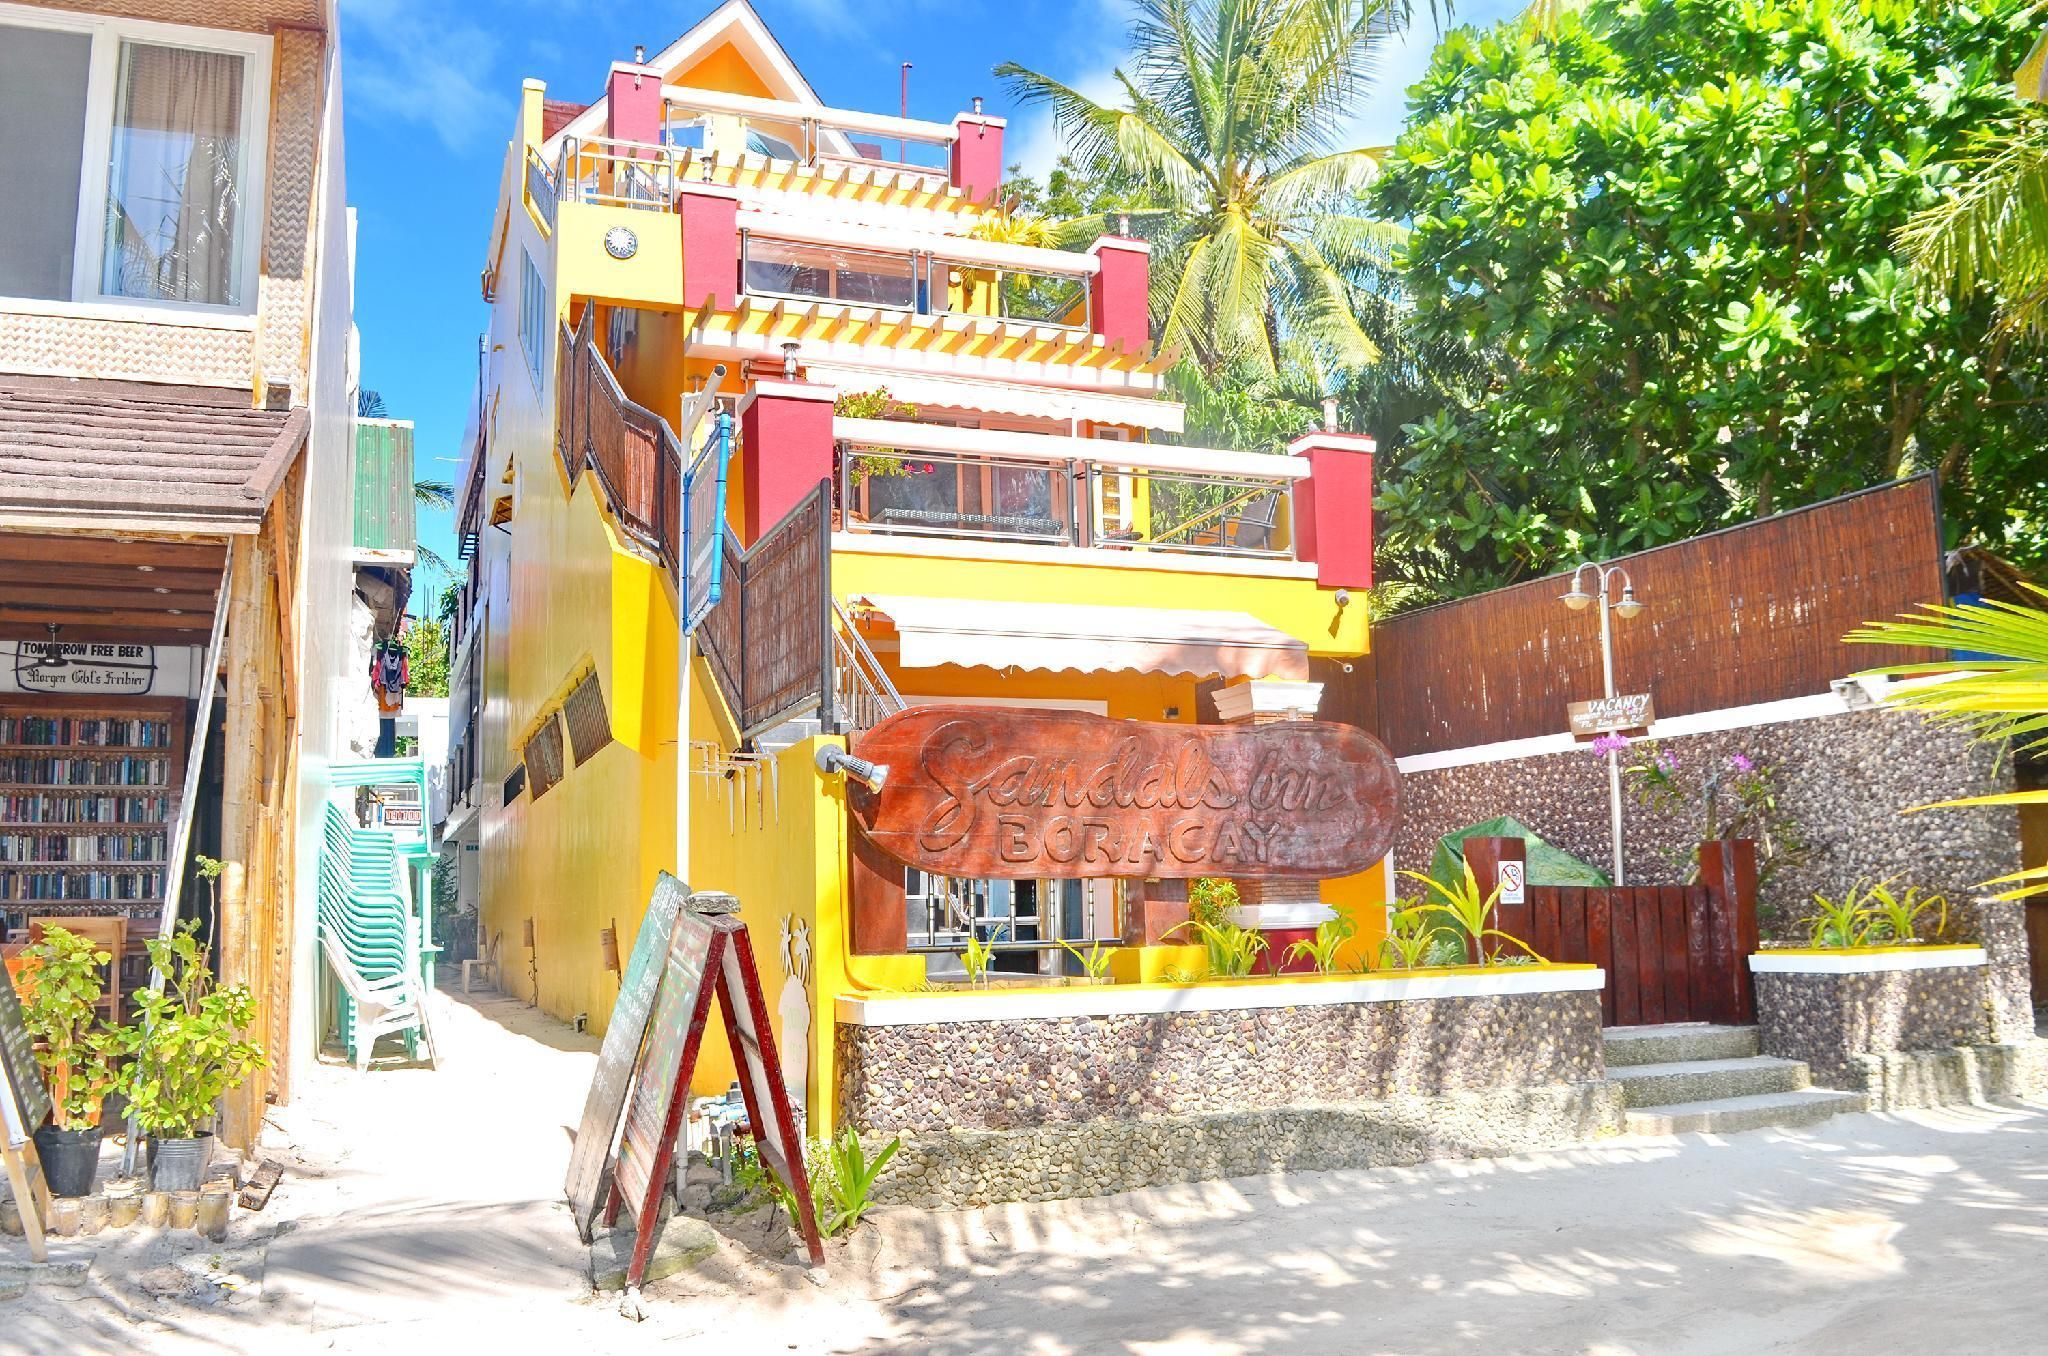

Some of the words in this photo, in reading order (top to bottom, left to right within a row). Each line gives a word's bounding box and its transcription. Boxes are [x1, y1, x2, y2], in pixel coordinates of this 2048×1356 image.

[24, 642, 88, 656] TOMRROW
[90, 644, 115, 657] FREE
[118, 646, 144, 658] BEER
[27, 668, 66, 688] Morgen
[1588, 693, 1649, 713] VACANCY
[916, 719, 1240, 853] Sandals
[1245, 750, 1349, 814] Inn
[998, 814, 1281, 865] BORACAY
